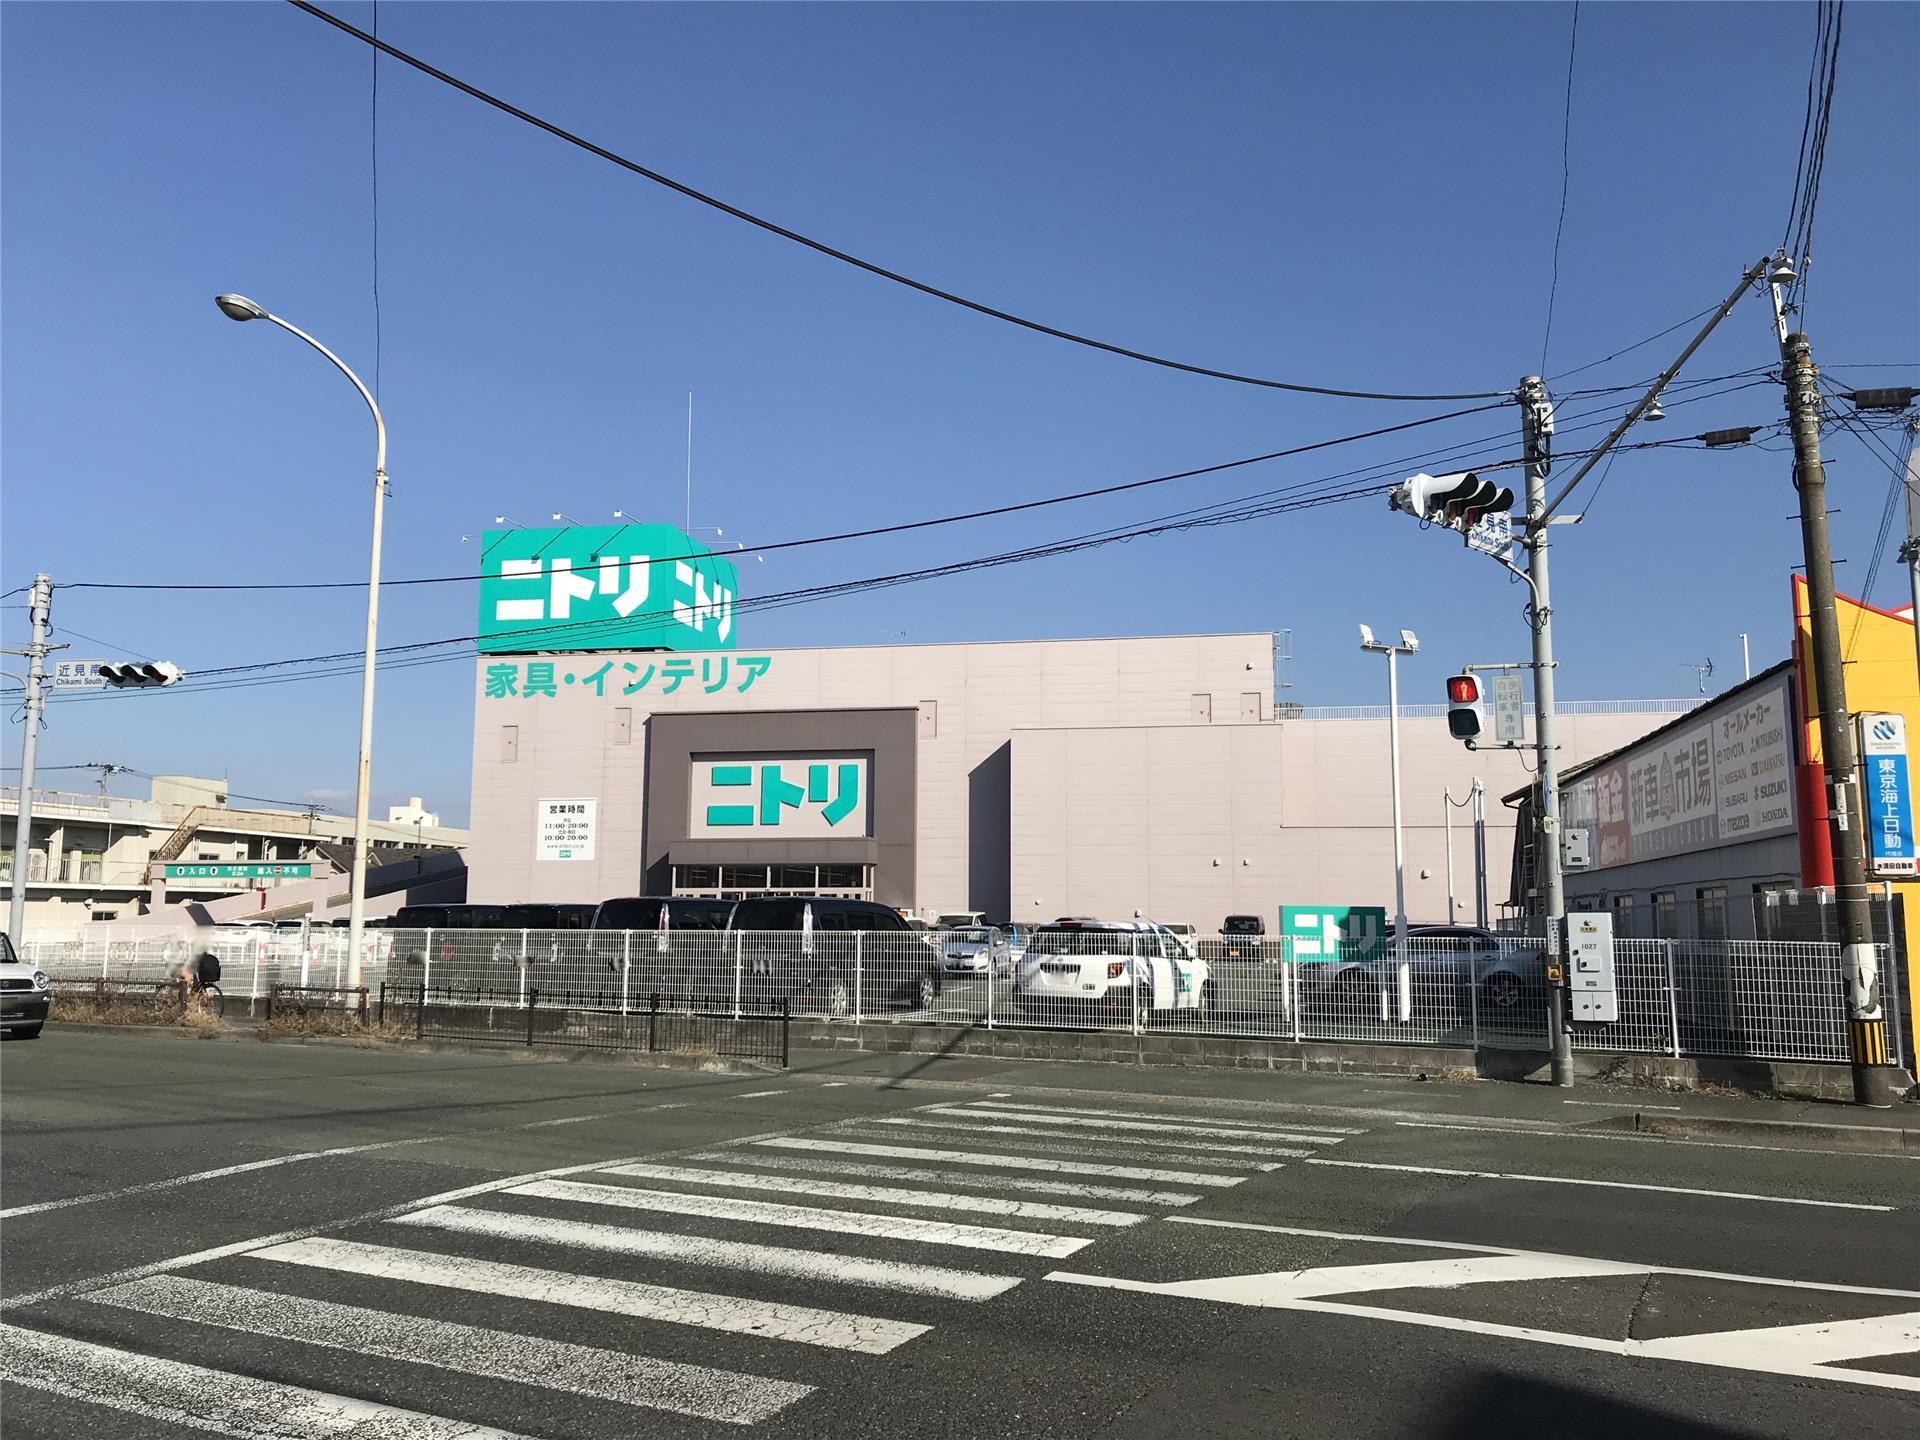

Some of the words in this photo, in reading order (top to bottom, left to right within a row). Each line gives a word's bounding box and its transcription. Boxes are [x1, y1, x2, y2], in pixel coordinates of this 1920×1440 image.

[496, 555, 650, 620] ニトリ
[673, 560, 732, 645] ニトリ
[59, 664, 101, 677] 近見南
[484, 656, 772, 699] 家具・インテリア
[56, 678, 82, 686] Chikami
[84, 677, 103, 686] South
[1723, 703, 1771, 739] オールメーカー
[1723, 741, 1745, 761] TOYOTA
[1760, 753, 1785, 774] DAIHATSU
[1724, 767, 1747, 785] NISSAN
[707, 764, 858, 827] ニトリ
[1726, 792, 1748, 808] SUBARU
[1760, 779, 1787, 800] SUZUKI
[549, 804, 585, 814] 営業時間
[1878, 758, 1902, 849] 東京海上日動
[1762, 807, 1789, 823] HONDA
[188, 867, 206, 875] 入口
[1293, 914, 1376, 956] ニトリ
